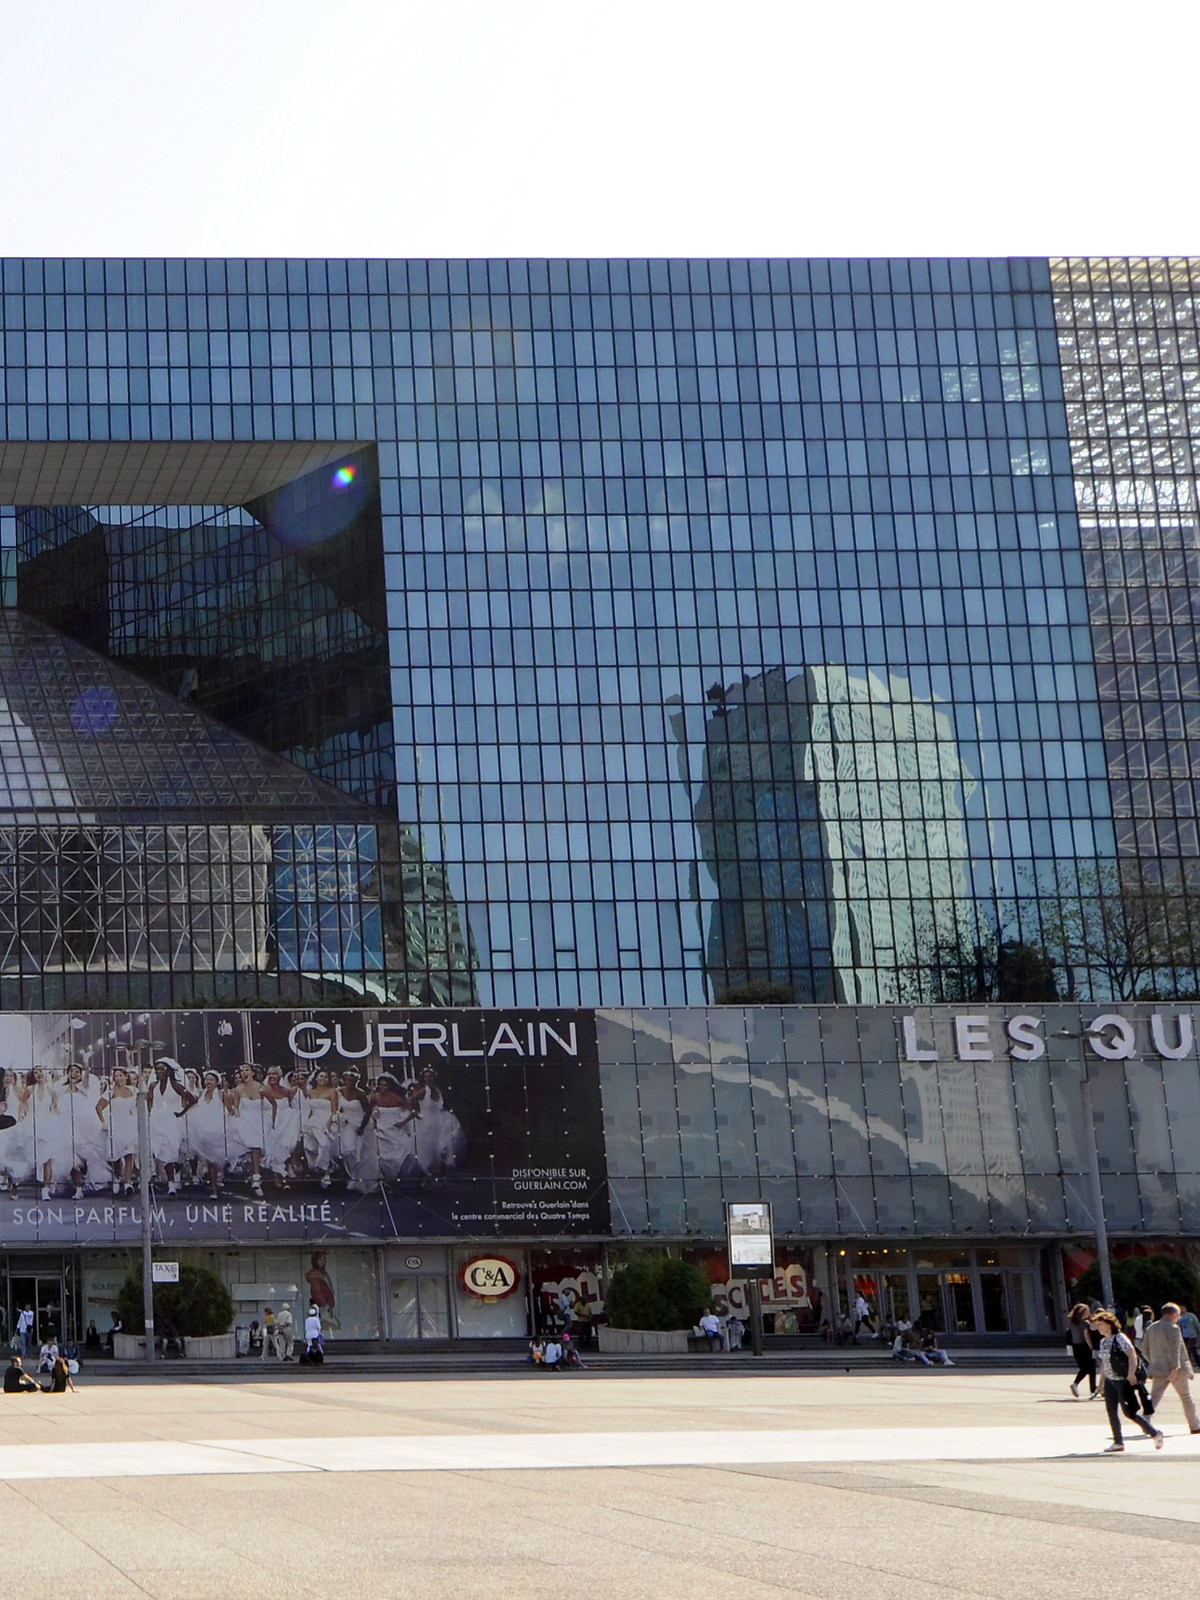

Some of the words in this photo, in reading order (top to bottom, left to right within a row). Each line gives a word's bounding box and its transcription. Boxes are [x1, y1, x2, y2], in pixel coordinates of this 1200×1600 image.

[288, 1021, 578, 1059] GUERLAIN
[903, 1015, 1046, 1061] LES
[512, 1168, 567, 1178] DISPONIBLE
[568, 1168, 587, 1178] SUR
[513, 1181, 588, 1190] GUERLAIN.COM
[538, 1201, 571, 1209] Guerlain
[571, 1201, 589, 1209] dans
[12, 1207, 63, 1226] SON
[75, 1205, 175, 1227] PARFUM,
[186, 1204, 232, 1223] UNE
[451, 1212, 458, 1221] le
[460, 1213, 483, 1221] centre
[484, 1212, 525, 1221] commercial
[540, 1211, 566, 1221] Quatre
[154, 1264, 178, 1273] TAXIS
[470, 1266, 511, 1287] C&A
